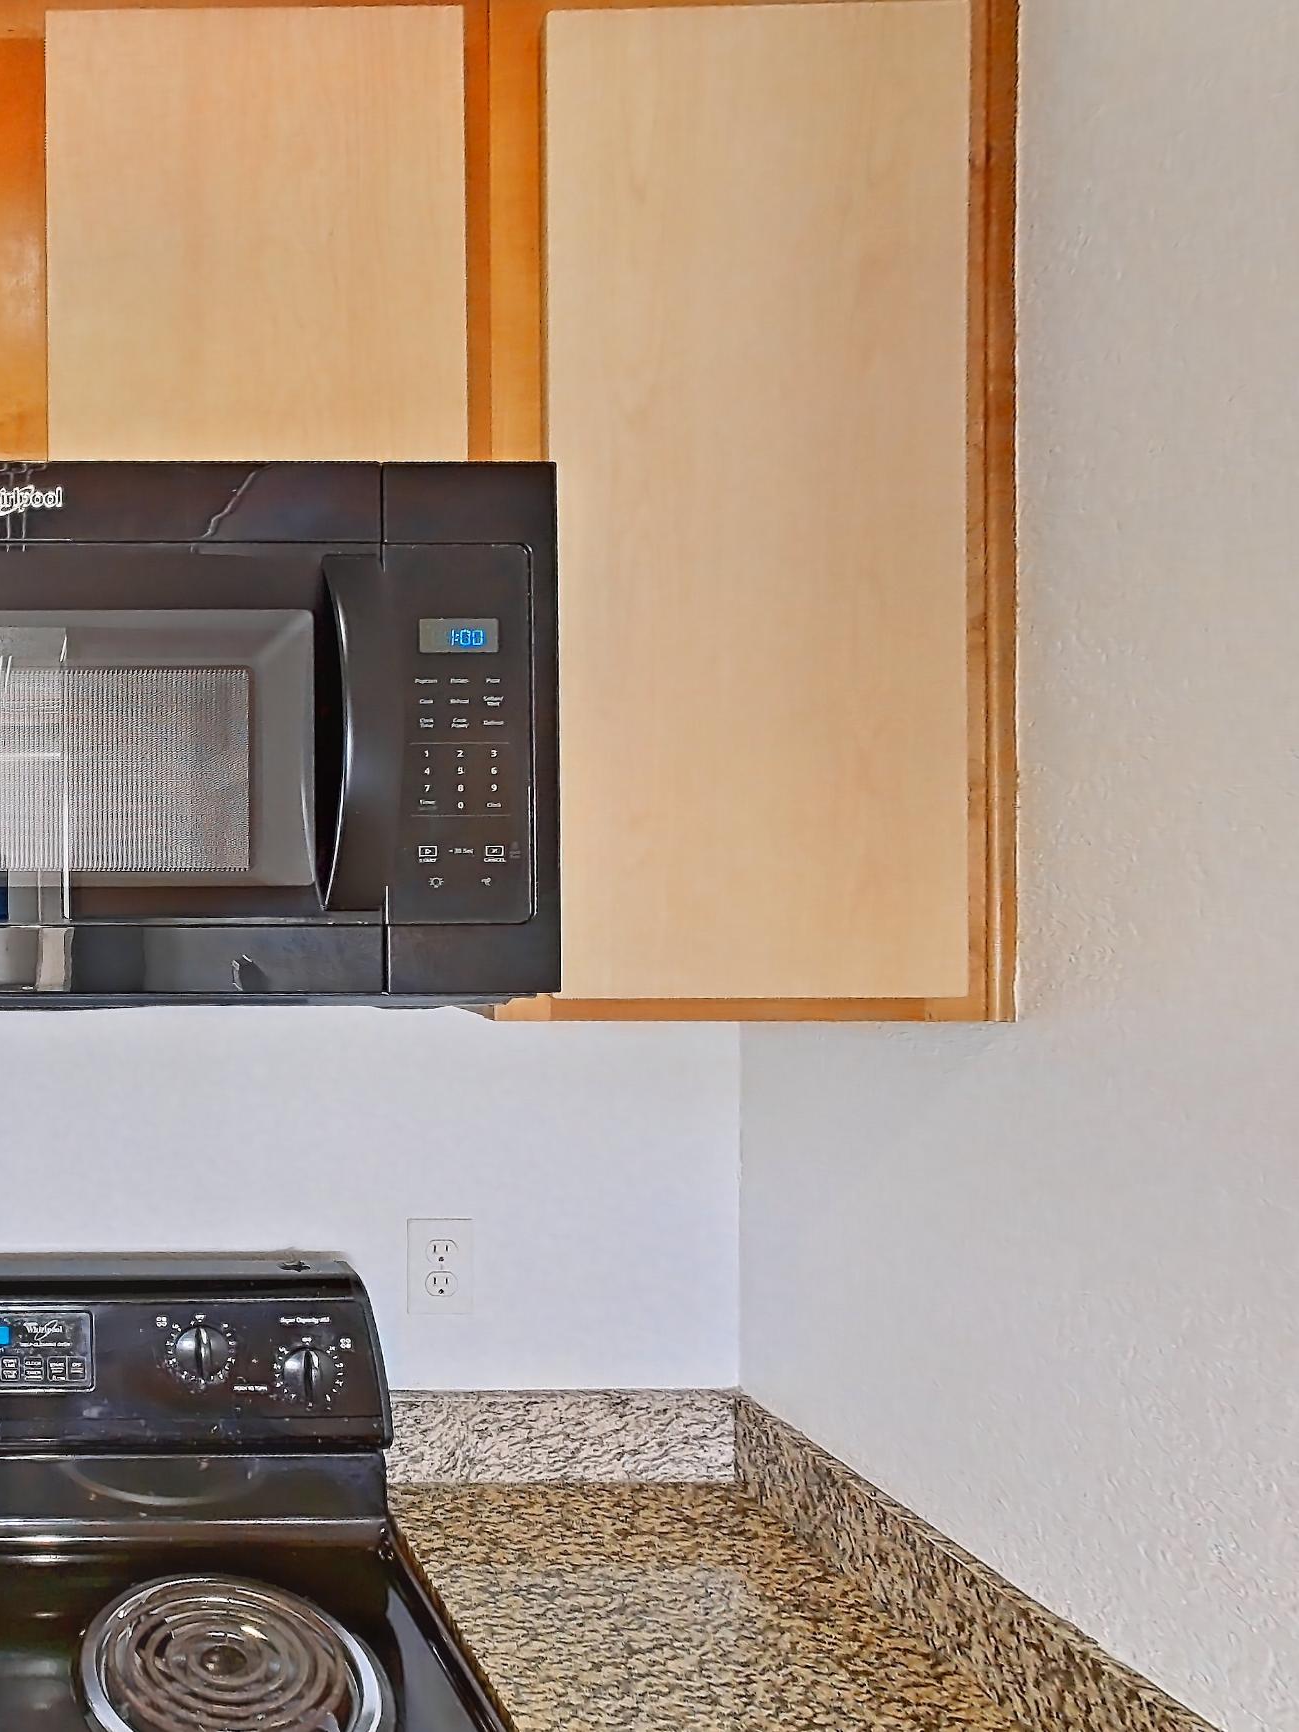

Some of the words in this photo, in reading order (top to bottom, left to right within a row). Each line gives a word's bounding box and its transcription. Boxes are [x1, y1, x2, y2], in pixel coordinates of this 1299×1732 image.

[451, 629, 483, 646] 1:00
[424, 749, 429, 758] 1
[456, 749, 464, 758] 2
[490, 749, 498, 758] 3
[424, 767, 431, 775] 4
[490, 767, 498, 775] 6
[424, 784, 431, 792] 7
[457, 784, 465, 792] 8
[490, 784, 498, 792] 9
[457, 801, 465, 809] 0
